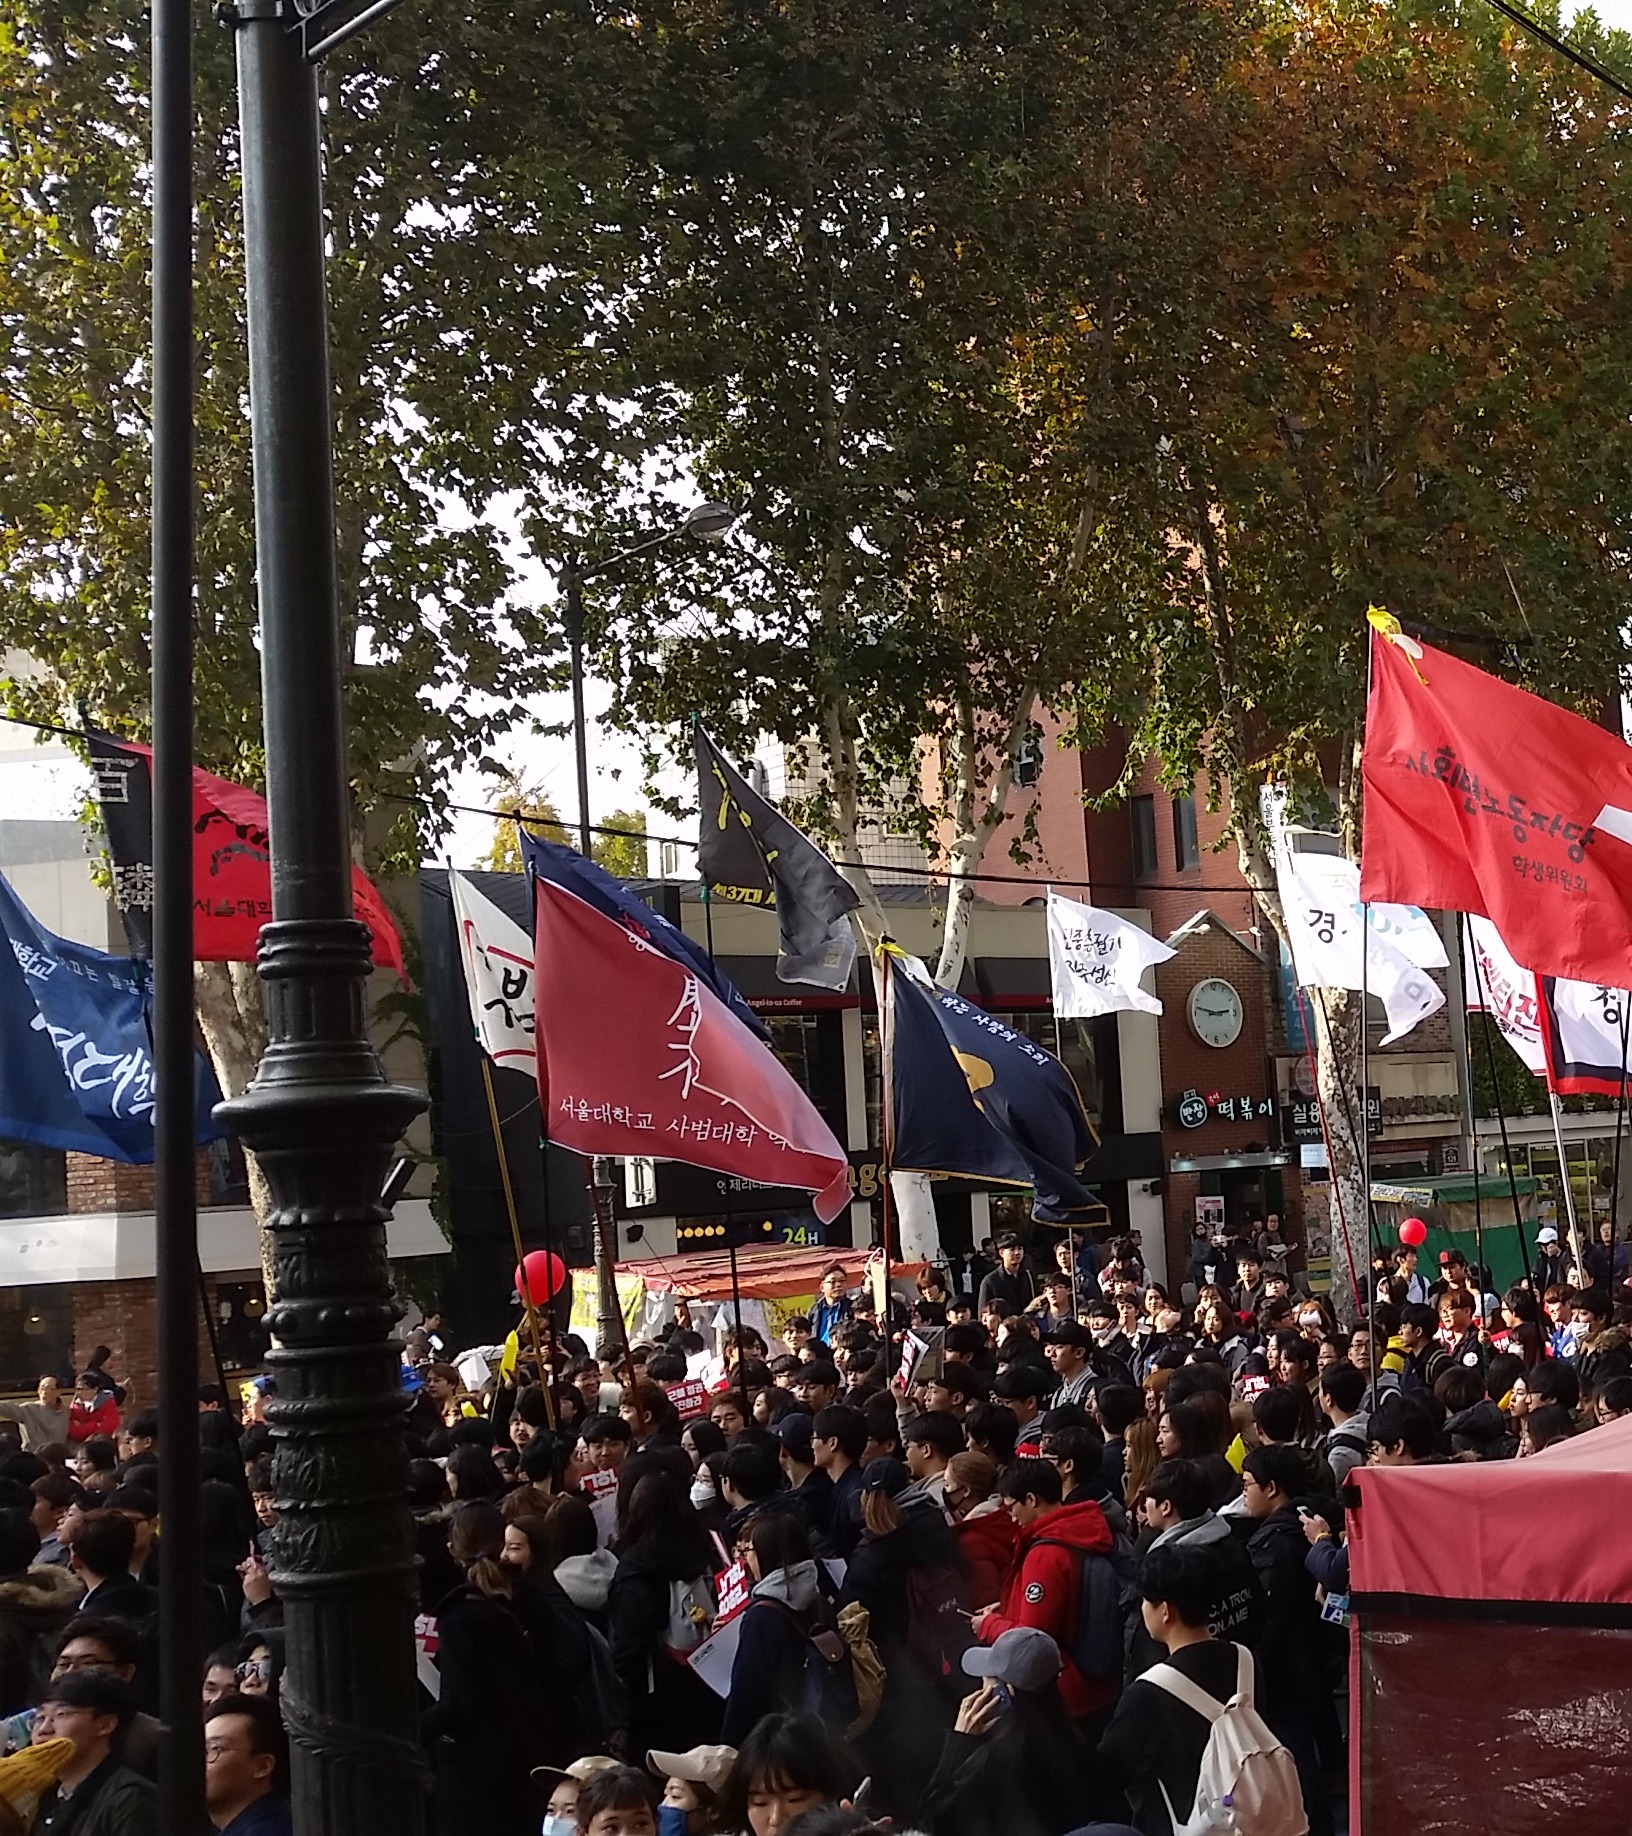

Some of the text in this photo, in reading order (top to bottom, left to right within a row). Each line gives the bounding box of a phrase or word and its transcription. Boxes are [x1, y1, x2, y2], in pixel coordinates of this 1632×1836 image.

[1511, 853, 1589, 895] 학생위원회
[559, 1095, 656, 1130] 서울대학교
[665, 1114, 758, 1148] 사범대학
[1217, 1095, 1273, 1121] 떡볶이
[782, 1225, 819, 1245] 24H
